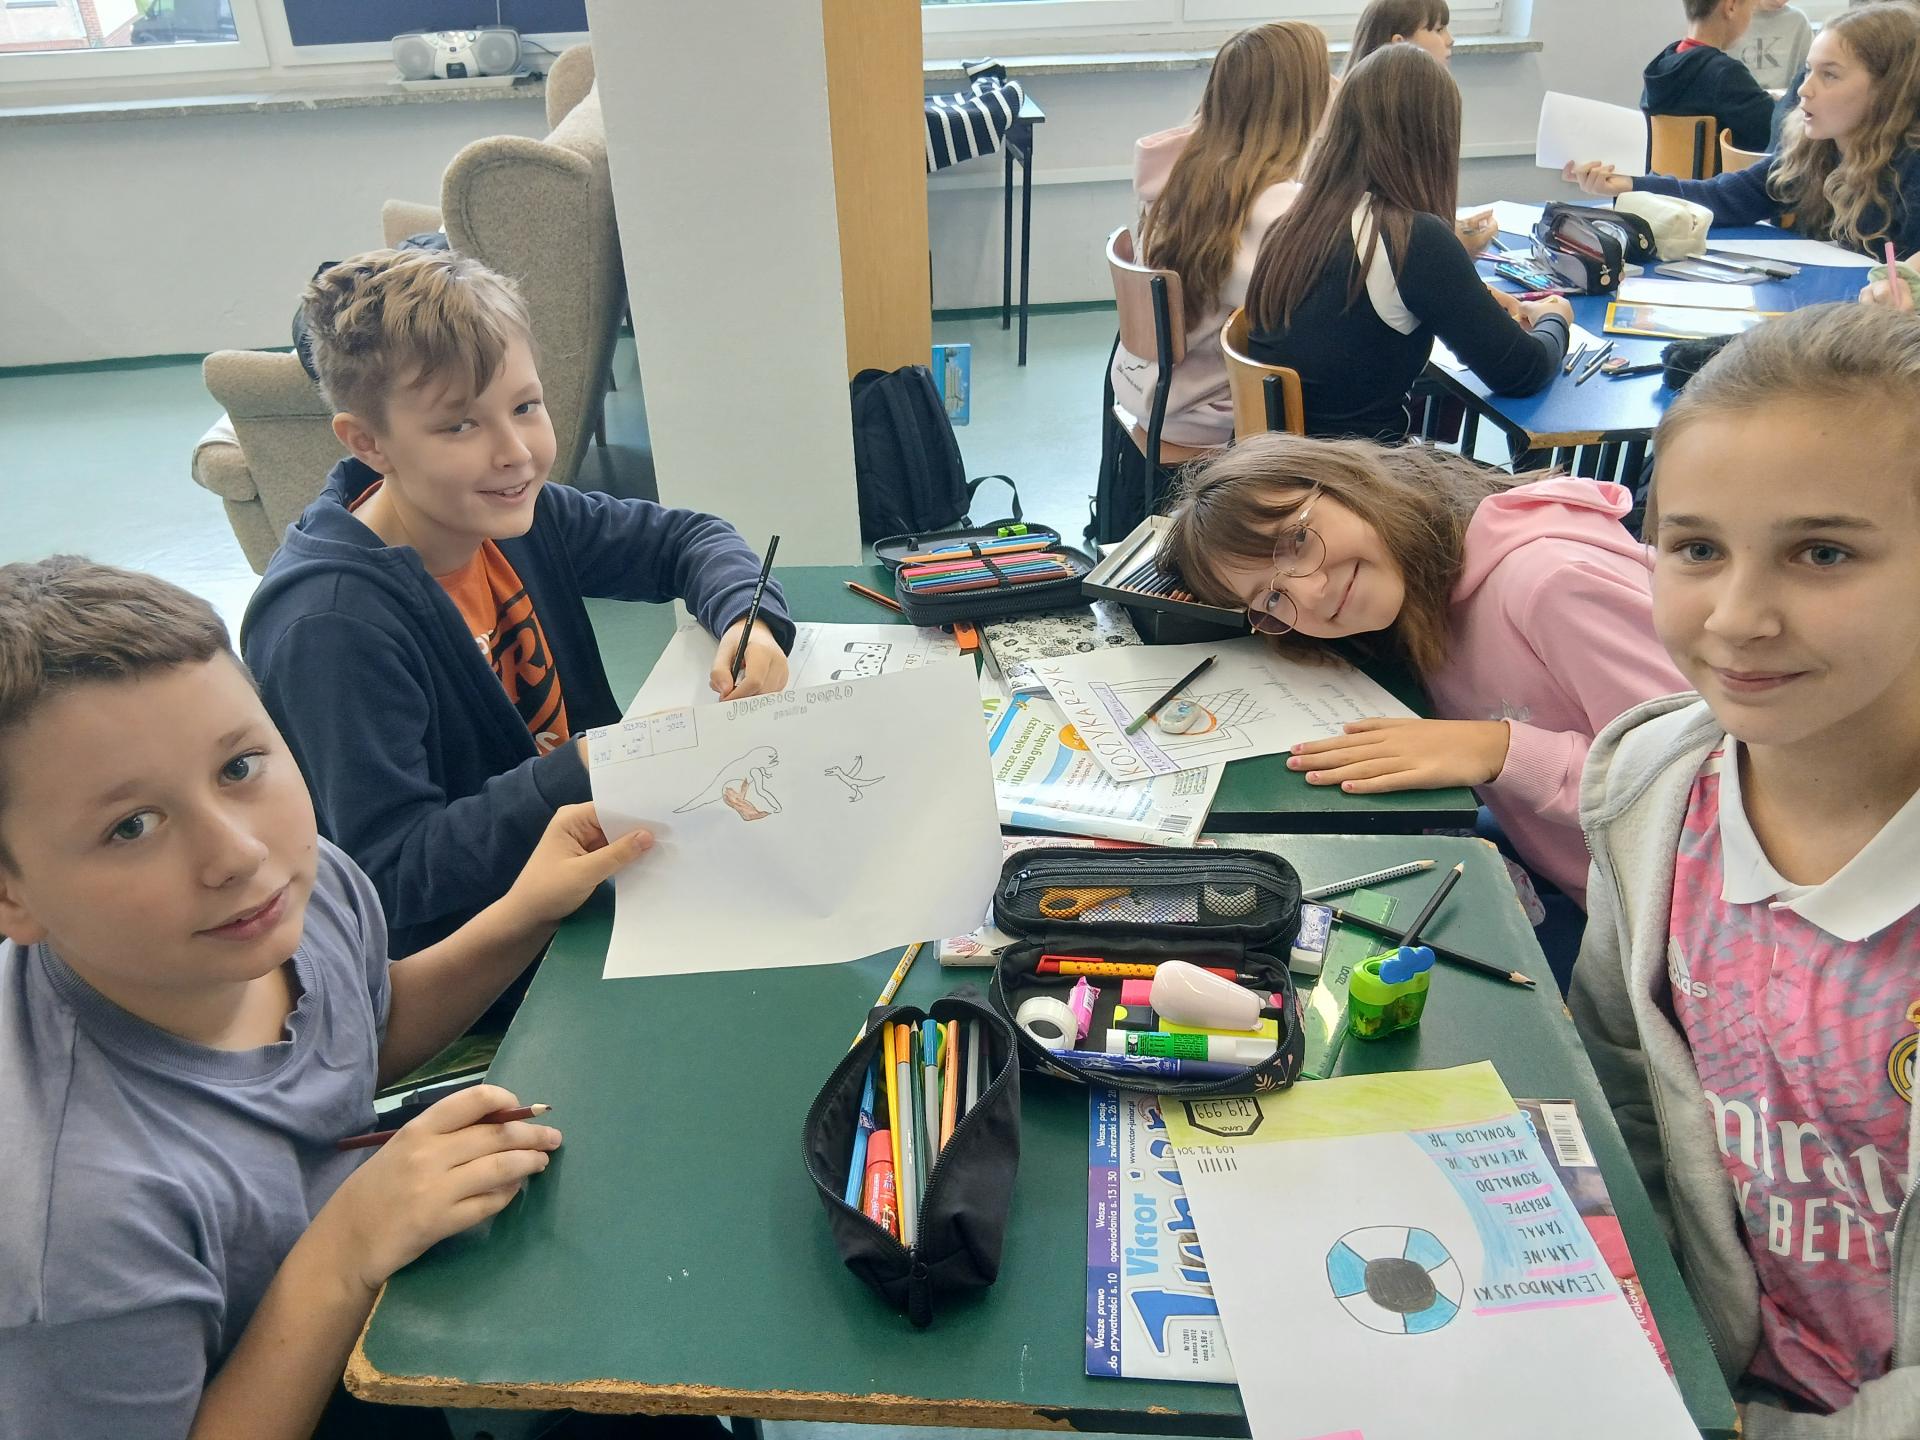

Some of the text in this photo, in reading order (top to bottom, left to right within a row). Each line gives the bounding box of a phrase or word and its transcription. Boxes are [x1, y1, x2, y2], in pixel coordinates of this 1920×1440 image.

[1009, 715, 1040, 756] ciekawszy
[1027, 720, 1057, 758] grubszy!
[1096, 1102, 1107, 1145] Wasze pasje
[1127, 1100, 1137, 1163] www.victor-junior.pl
[1456, 1125, 1516, 1144] RONALDO
[1108, 1123, 1117, 1157] zwierzaki
[1470, 1149, 1529, 1169] NEYMAR
[1108, 1170, 1117, 1181] 30
[1476, 1171, 1542, 1193] RONALDO
[1108, 1189, 1117, 1197] 13
[1095, 1201, 1105, 1227] Wasze
[1518, 1219, 1565, 1240] YAMAL
[1109, 1210, 1118, 1262] opowiadania
[1125, 1192, 1158, 1276] Victor
[1107, 1272, 1117, 1284] 10
[1473, 1272, 1606, 1301] LEWANDOWSKI
[1094, 1288, 1106, 1348] Wasze prawo
[1107, 1296, 1118, 1351] prywatności
